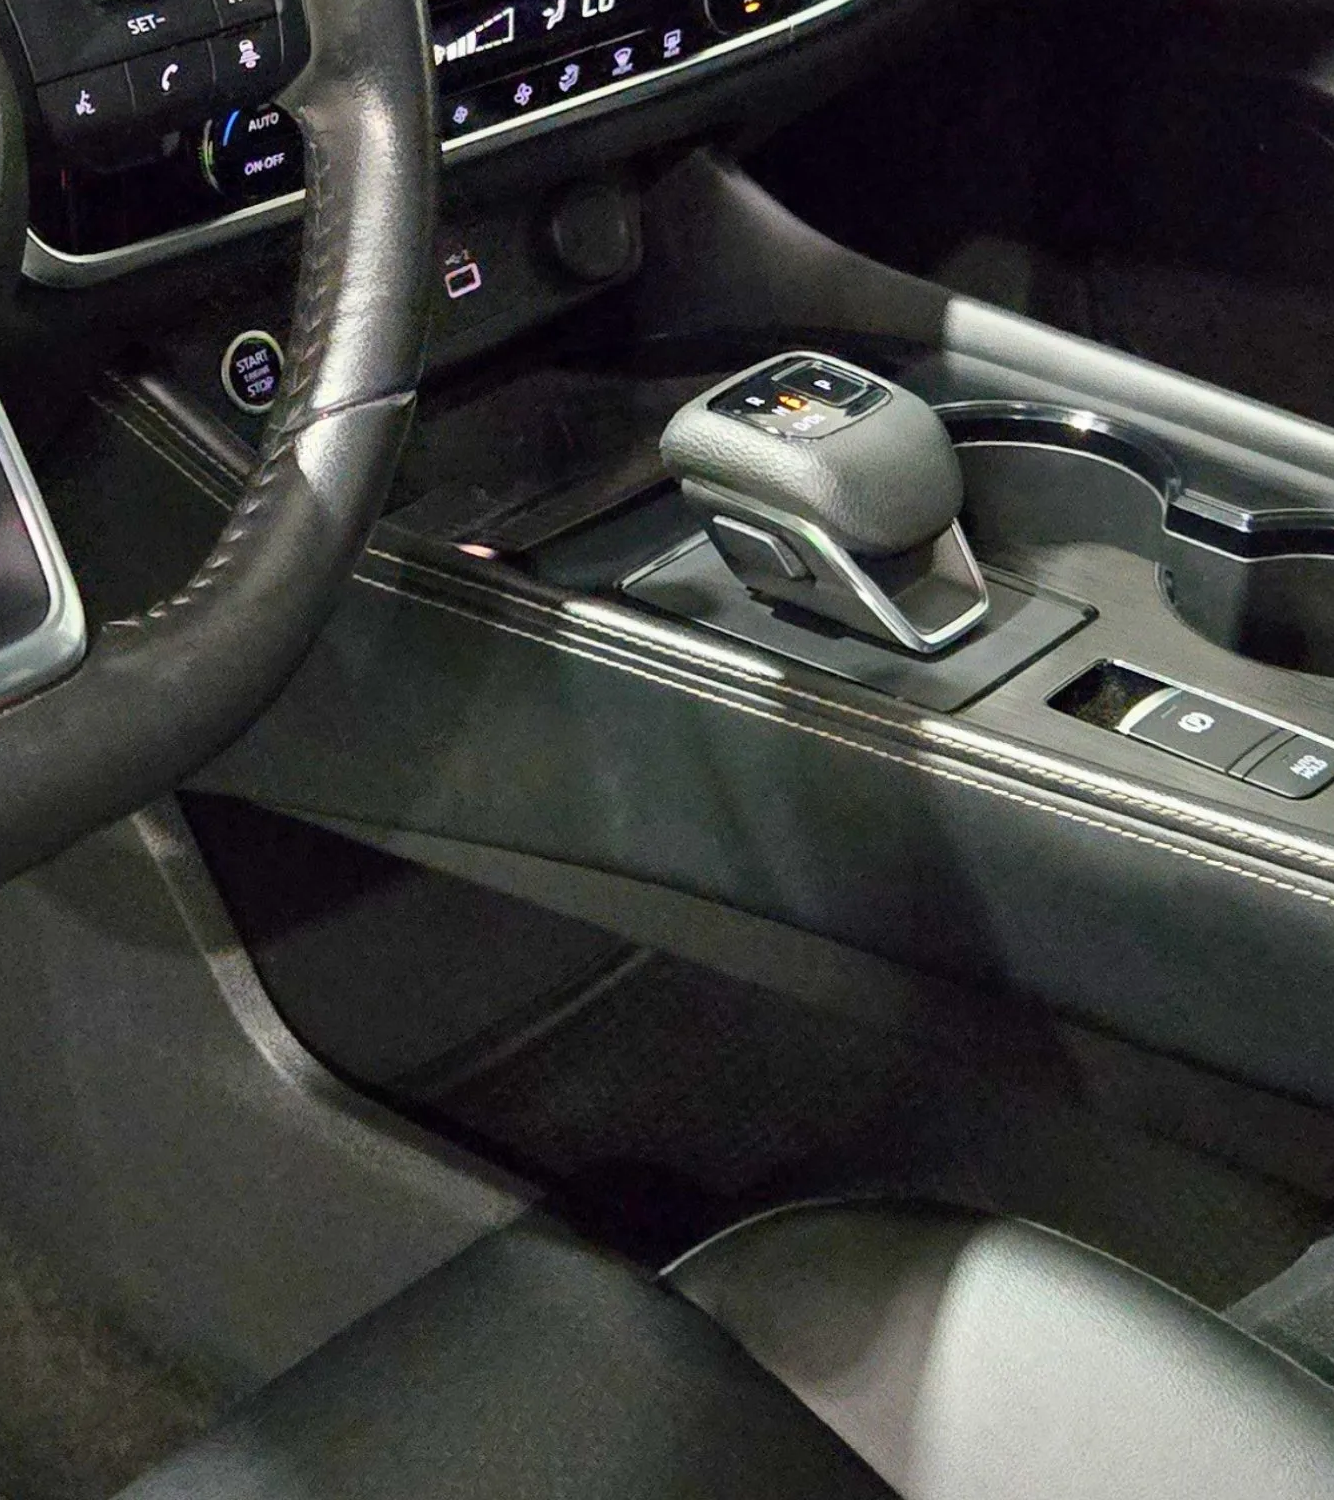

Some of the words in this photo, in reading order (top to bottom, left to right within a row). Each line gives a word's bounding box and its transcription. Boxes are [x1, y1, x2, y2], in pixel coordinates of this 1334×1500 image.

[248, 111, 280, 133] AUTO
[236, 349, 269, 374] START
[247, 375, 275, 397] STOP
